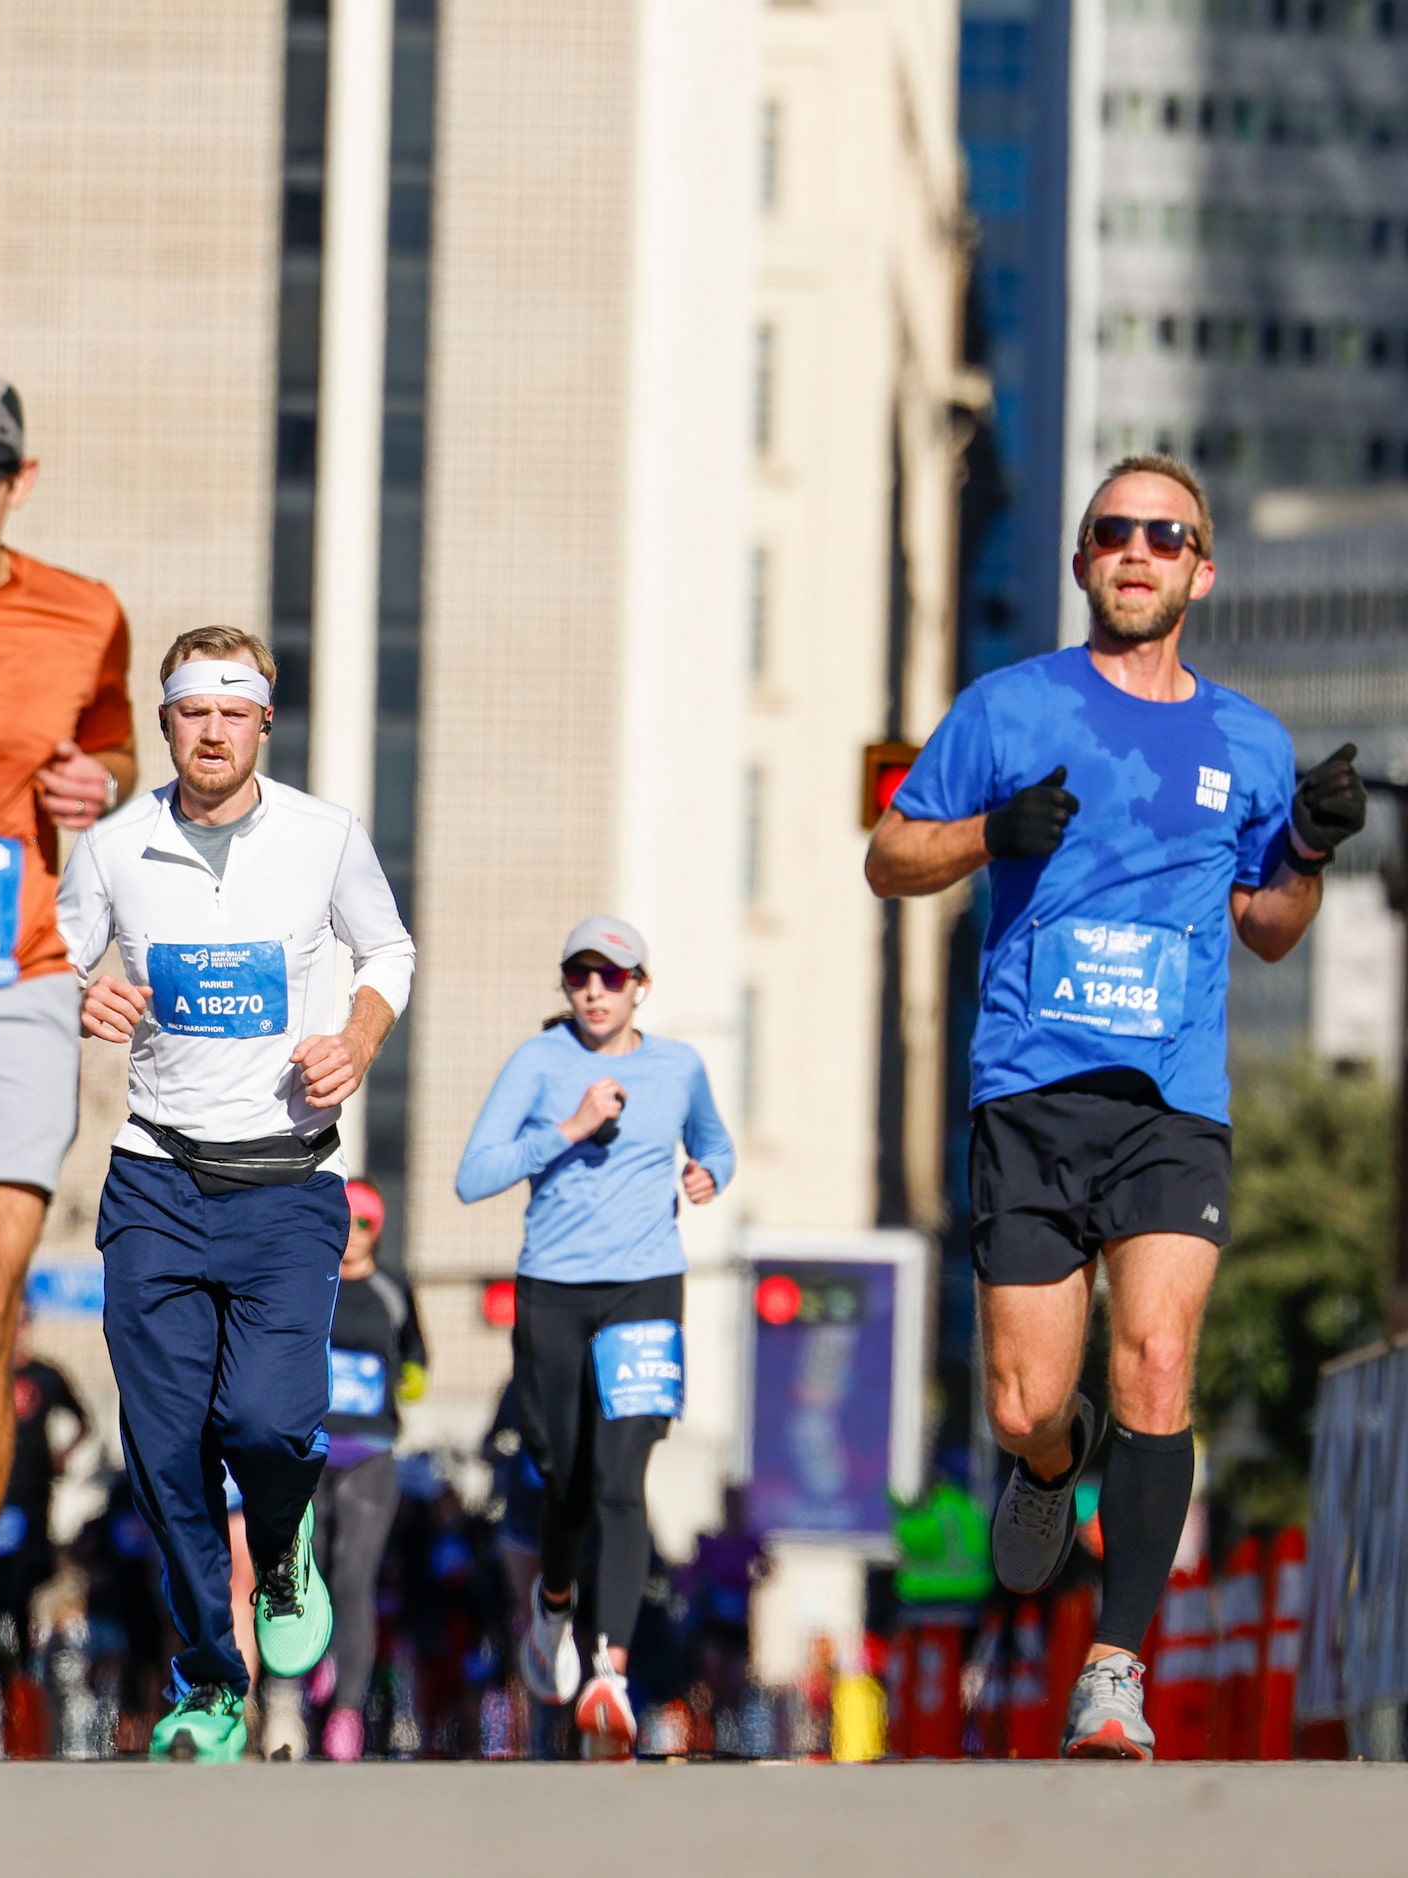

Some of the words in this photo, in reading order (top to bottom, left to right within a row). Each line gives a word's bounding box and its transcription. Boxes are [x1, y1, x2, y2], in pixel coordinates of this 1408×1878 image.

[1198, 765, 1231, 793] TEAM
[1076, 960, 1099, 974] RUN
[1106, 964, 1144, 979] AUSTIN
[199, 980, 234, 989] PARKER
[1054, 977, 1075, 1001] A
[1082, 980, 1159, 1011] 13432
[175, 995, 191, 1014] A
[196, 994, 264, 1015] 18270
[1040, 1008, 1061, 1020] HALF
[1061, 1012, 1111, 1026] MARATHON
[168, 1022, 183, 1030] HALF
[183, 1025, 225, 1033] MARATHON
[616, 1363, 634, 1382] A
